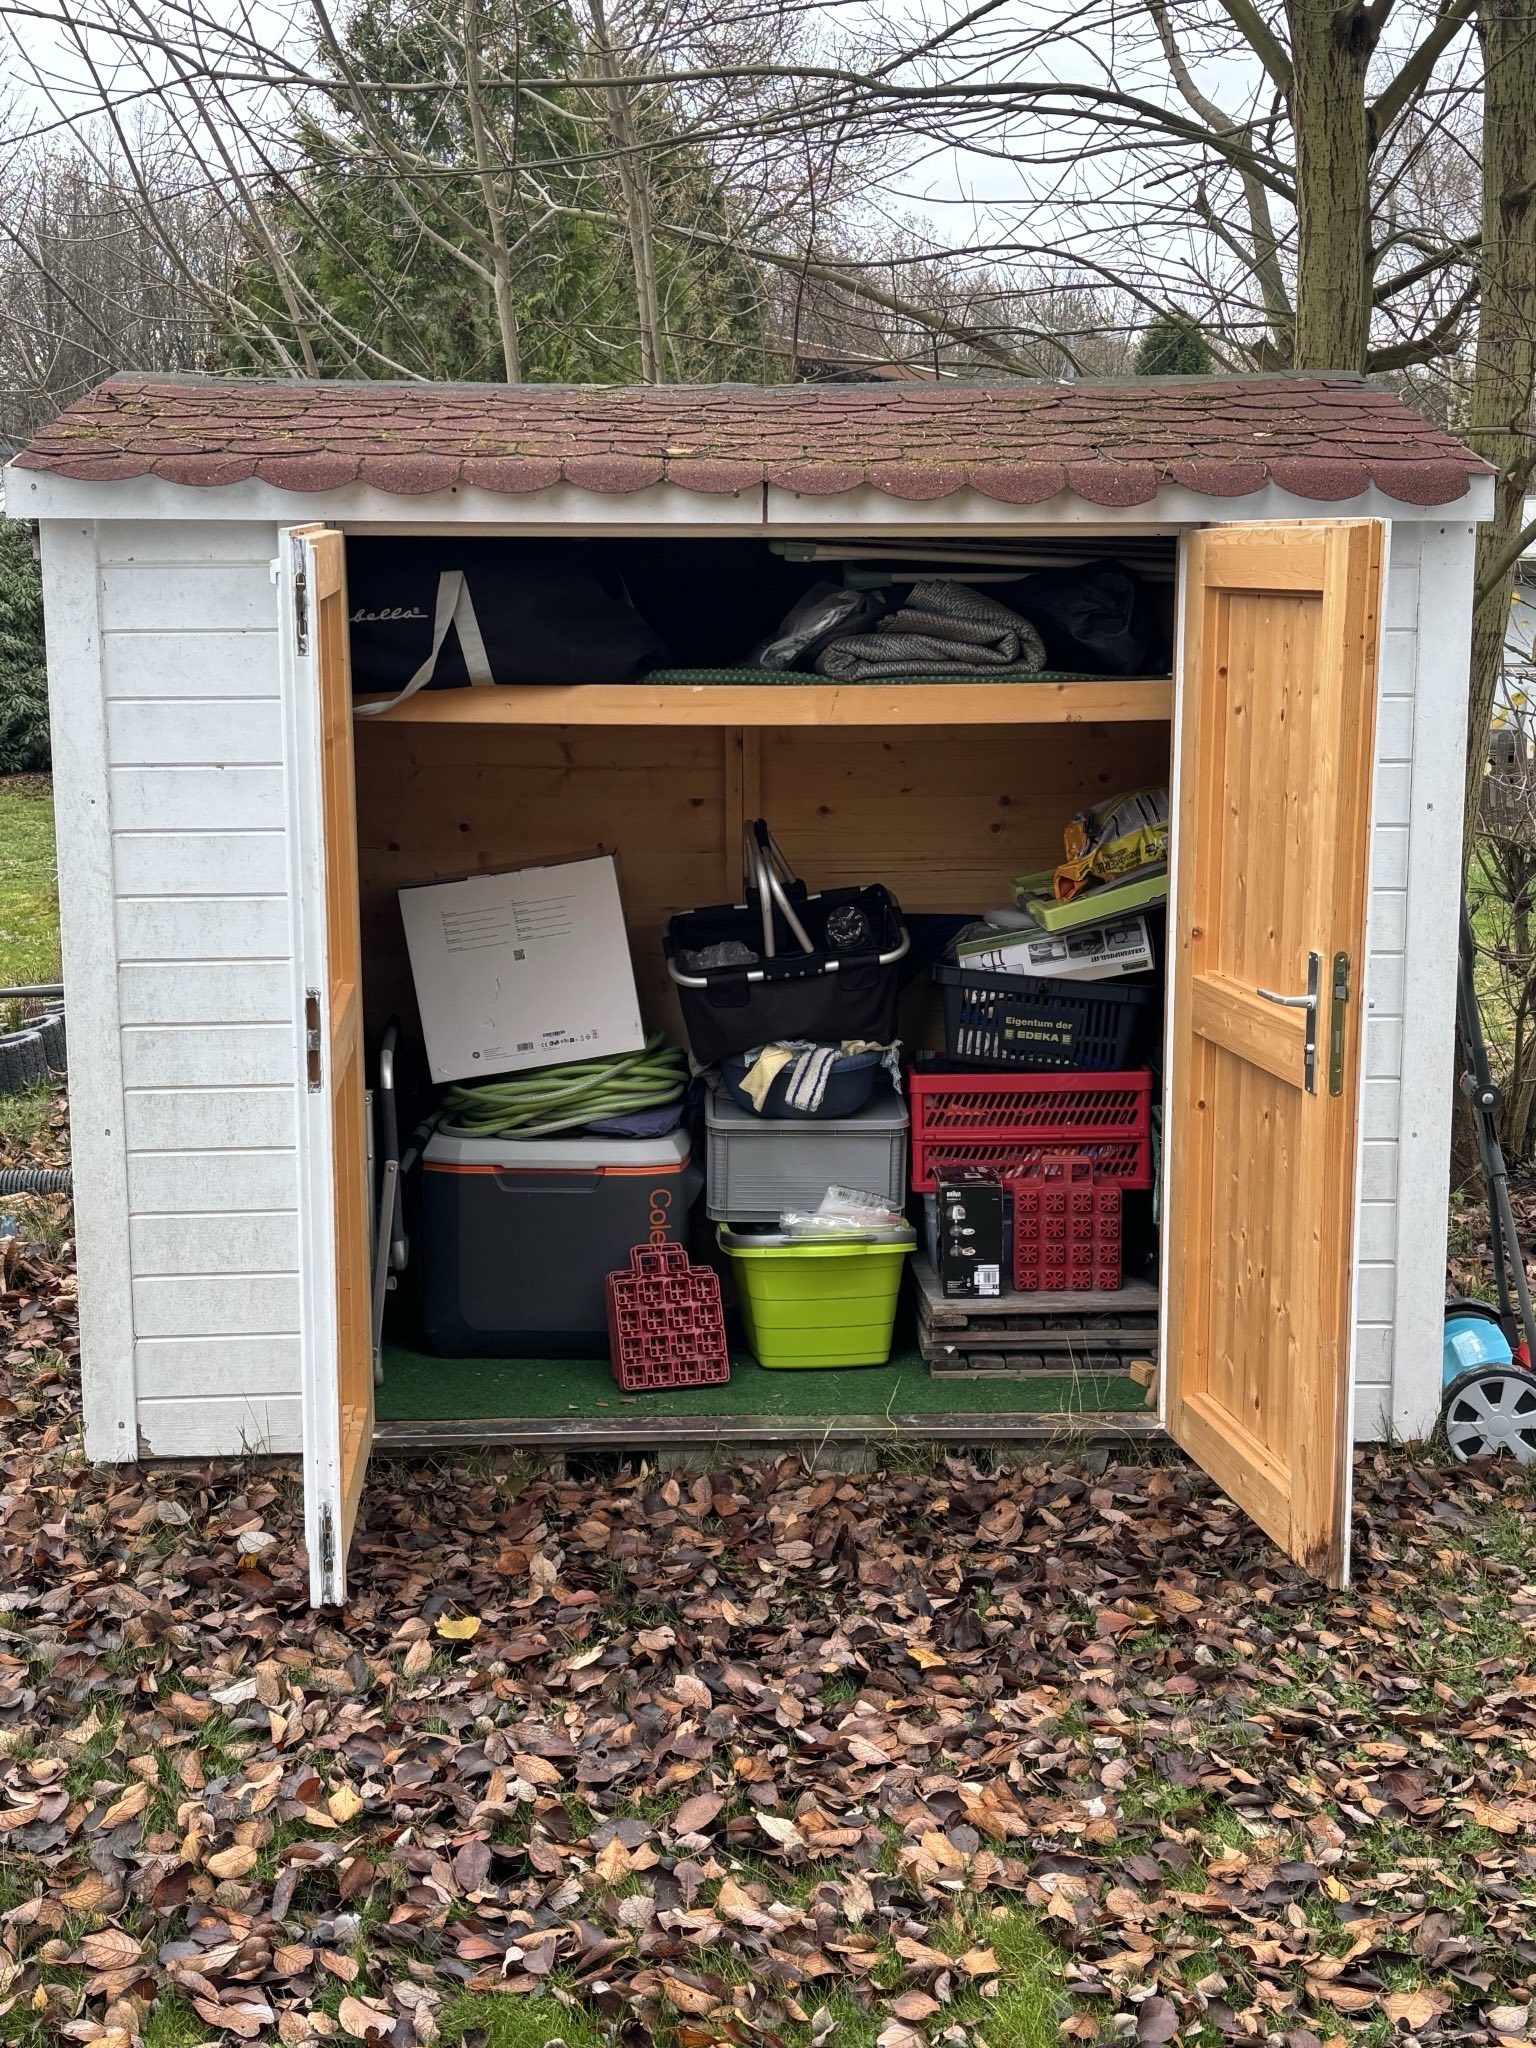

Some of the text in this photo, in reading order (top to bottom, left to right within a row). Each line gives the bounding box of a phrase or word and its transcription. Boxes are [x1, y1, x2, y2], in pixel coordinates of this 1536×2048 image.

[349, 607, 429, 623] bella
[1005, 1016, 1073, 1030] Eigentum der
[1016, 1030, 1059, 1042] EDEKA
[649, 1188, 672, 1246] Cole
